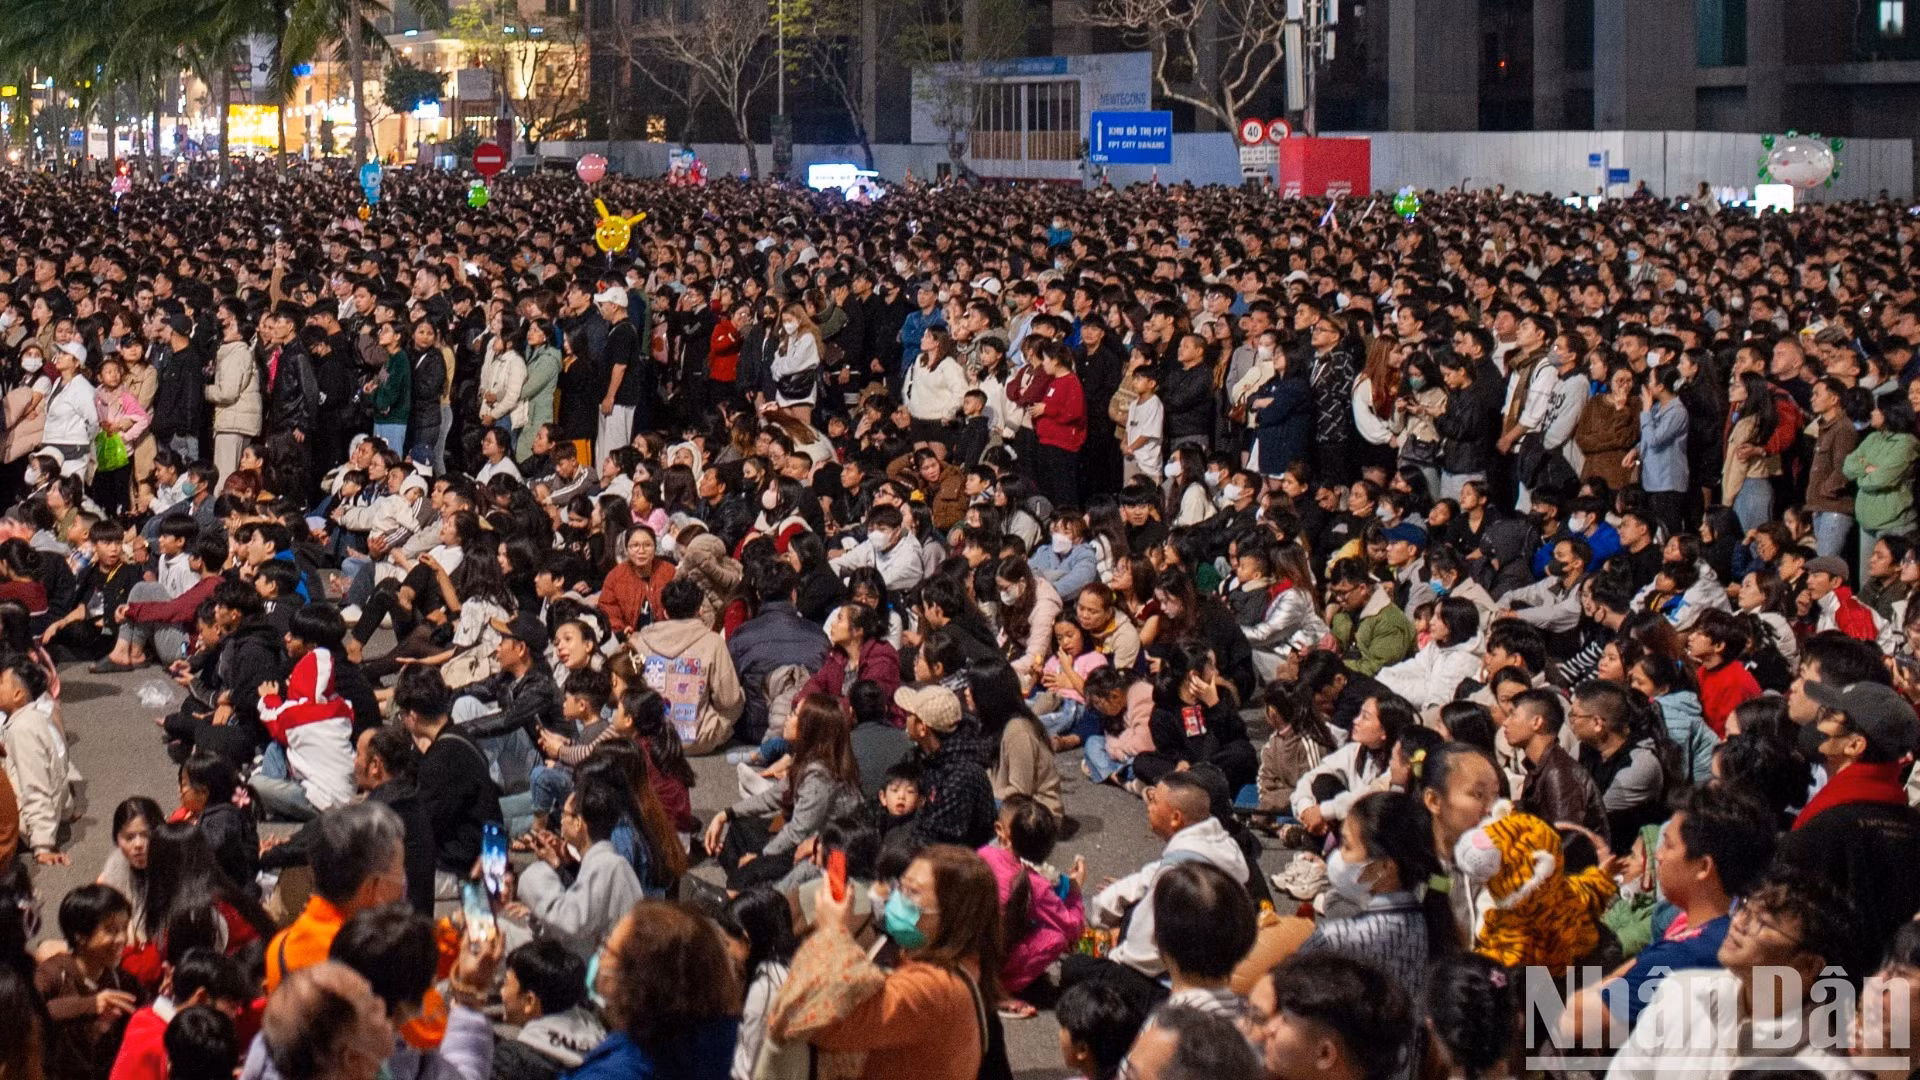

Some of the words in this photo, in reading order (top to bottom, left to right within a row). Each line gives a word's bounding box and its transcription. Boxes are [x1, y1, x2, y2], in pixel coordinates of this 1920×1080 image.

[1108, 127, 1124, 136] KHU
[1154, 127, 1166, 136] FPT
[1247, 126, 1259, 137] 40
